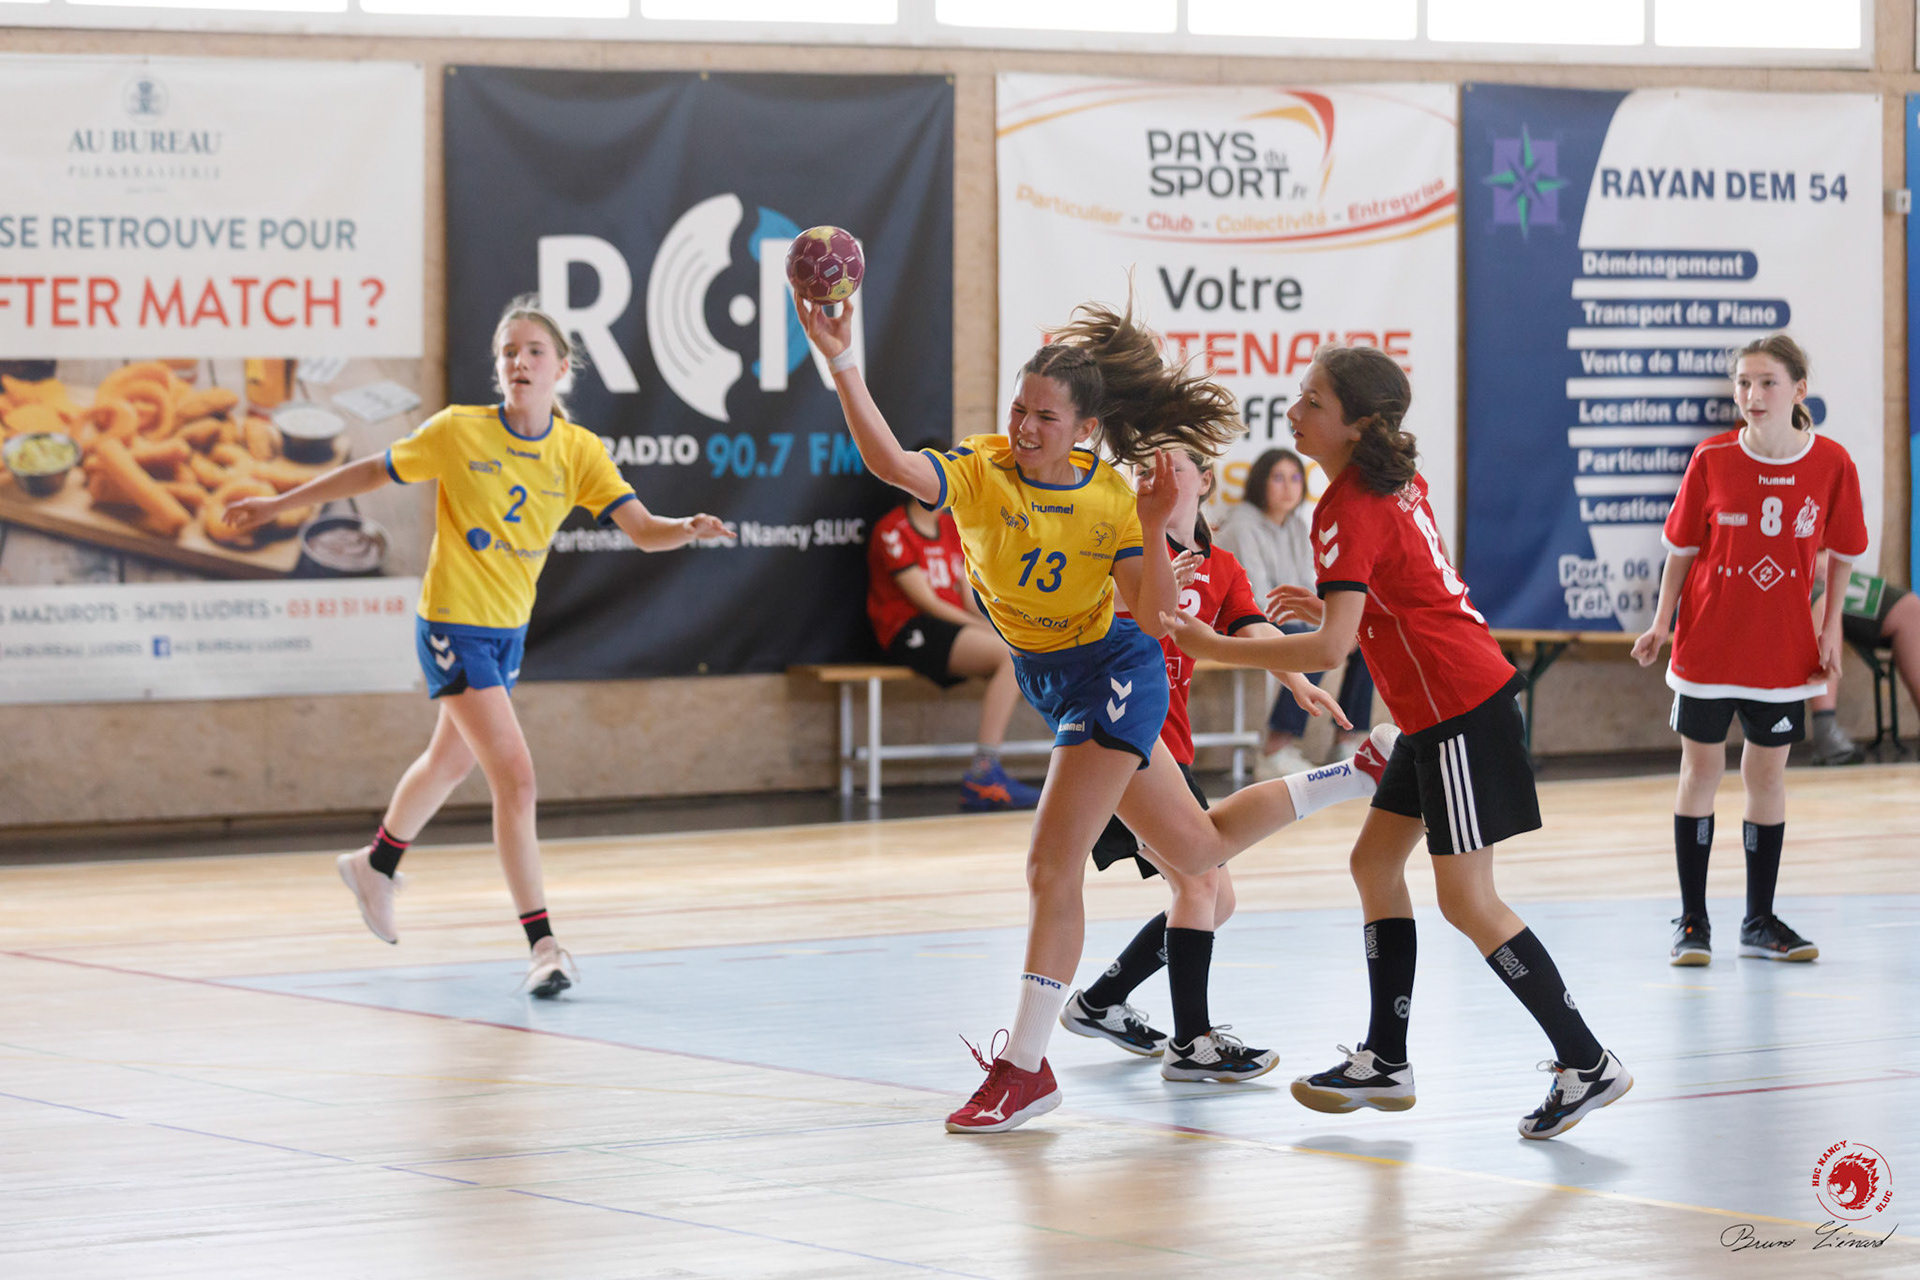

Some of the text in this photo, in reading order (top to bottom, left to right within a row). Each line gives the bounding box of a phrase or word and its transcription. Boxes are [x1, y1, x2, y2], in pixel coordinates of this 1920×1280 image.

[67, 128, 223, 155] AU BUREAU
[1146, 130, 1257, 162] PAYS
[1149, 165, 1290, 199] SPORT
[1600, 168, 1848, 202] RAYAN DEM 54
[1015, 182, 1124, 226] Particulier
[1146, 210, 1195, 233] Club
[1216, 212, 1328, 234] Collectivité
[1347, 176, 1447, 223] Entreprise
[0, 215, 357, 251] SE RETROUVE POUR
[1582, 252, 1744, 280] Déménagement
[138, 276, 342, 329] MATCH
[360, 277, 386, 328] ?
[1158, 267, 1303, 311] Votre
[1582, 300, 1777, 327] Transport de Piano
[1581, 350, 1643, 374] Vente
[1648, 352, 1672, 373] de
[1579, 399, 1671, 424] Location
[1676, 401, 1699, 422] de
[706, 433, 794, 478] 90.7
[1758, 474, 1795, 486] hummel
[503, 485, 528, 523] 2
[1031, 501, 1074, 515] hummel
[1760, 496, 1783, 537] 8
[741, 520, 811, 551] Nancy
[813, 518, 865, 547] SLUC
[1018, 547, 1067, 593] 13
[1623, 558, 1650, 580] 06
[1307, 763, 1352, 782] Kempa
